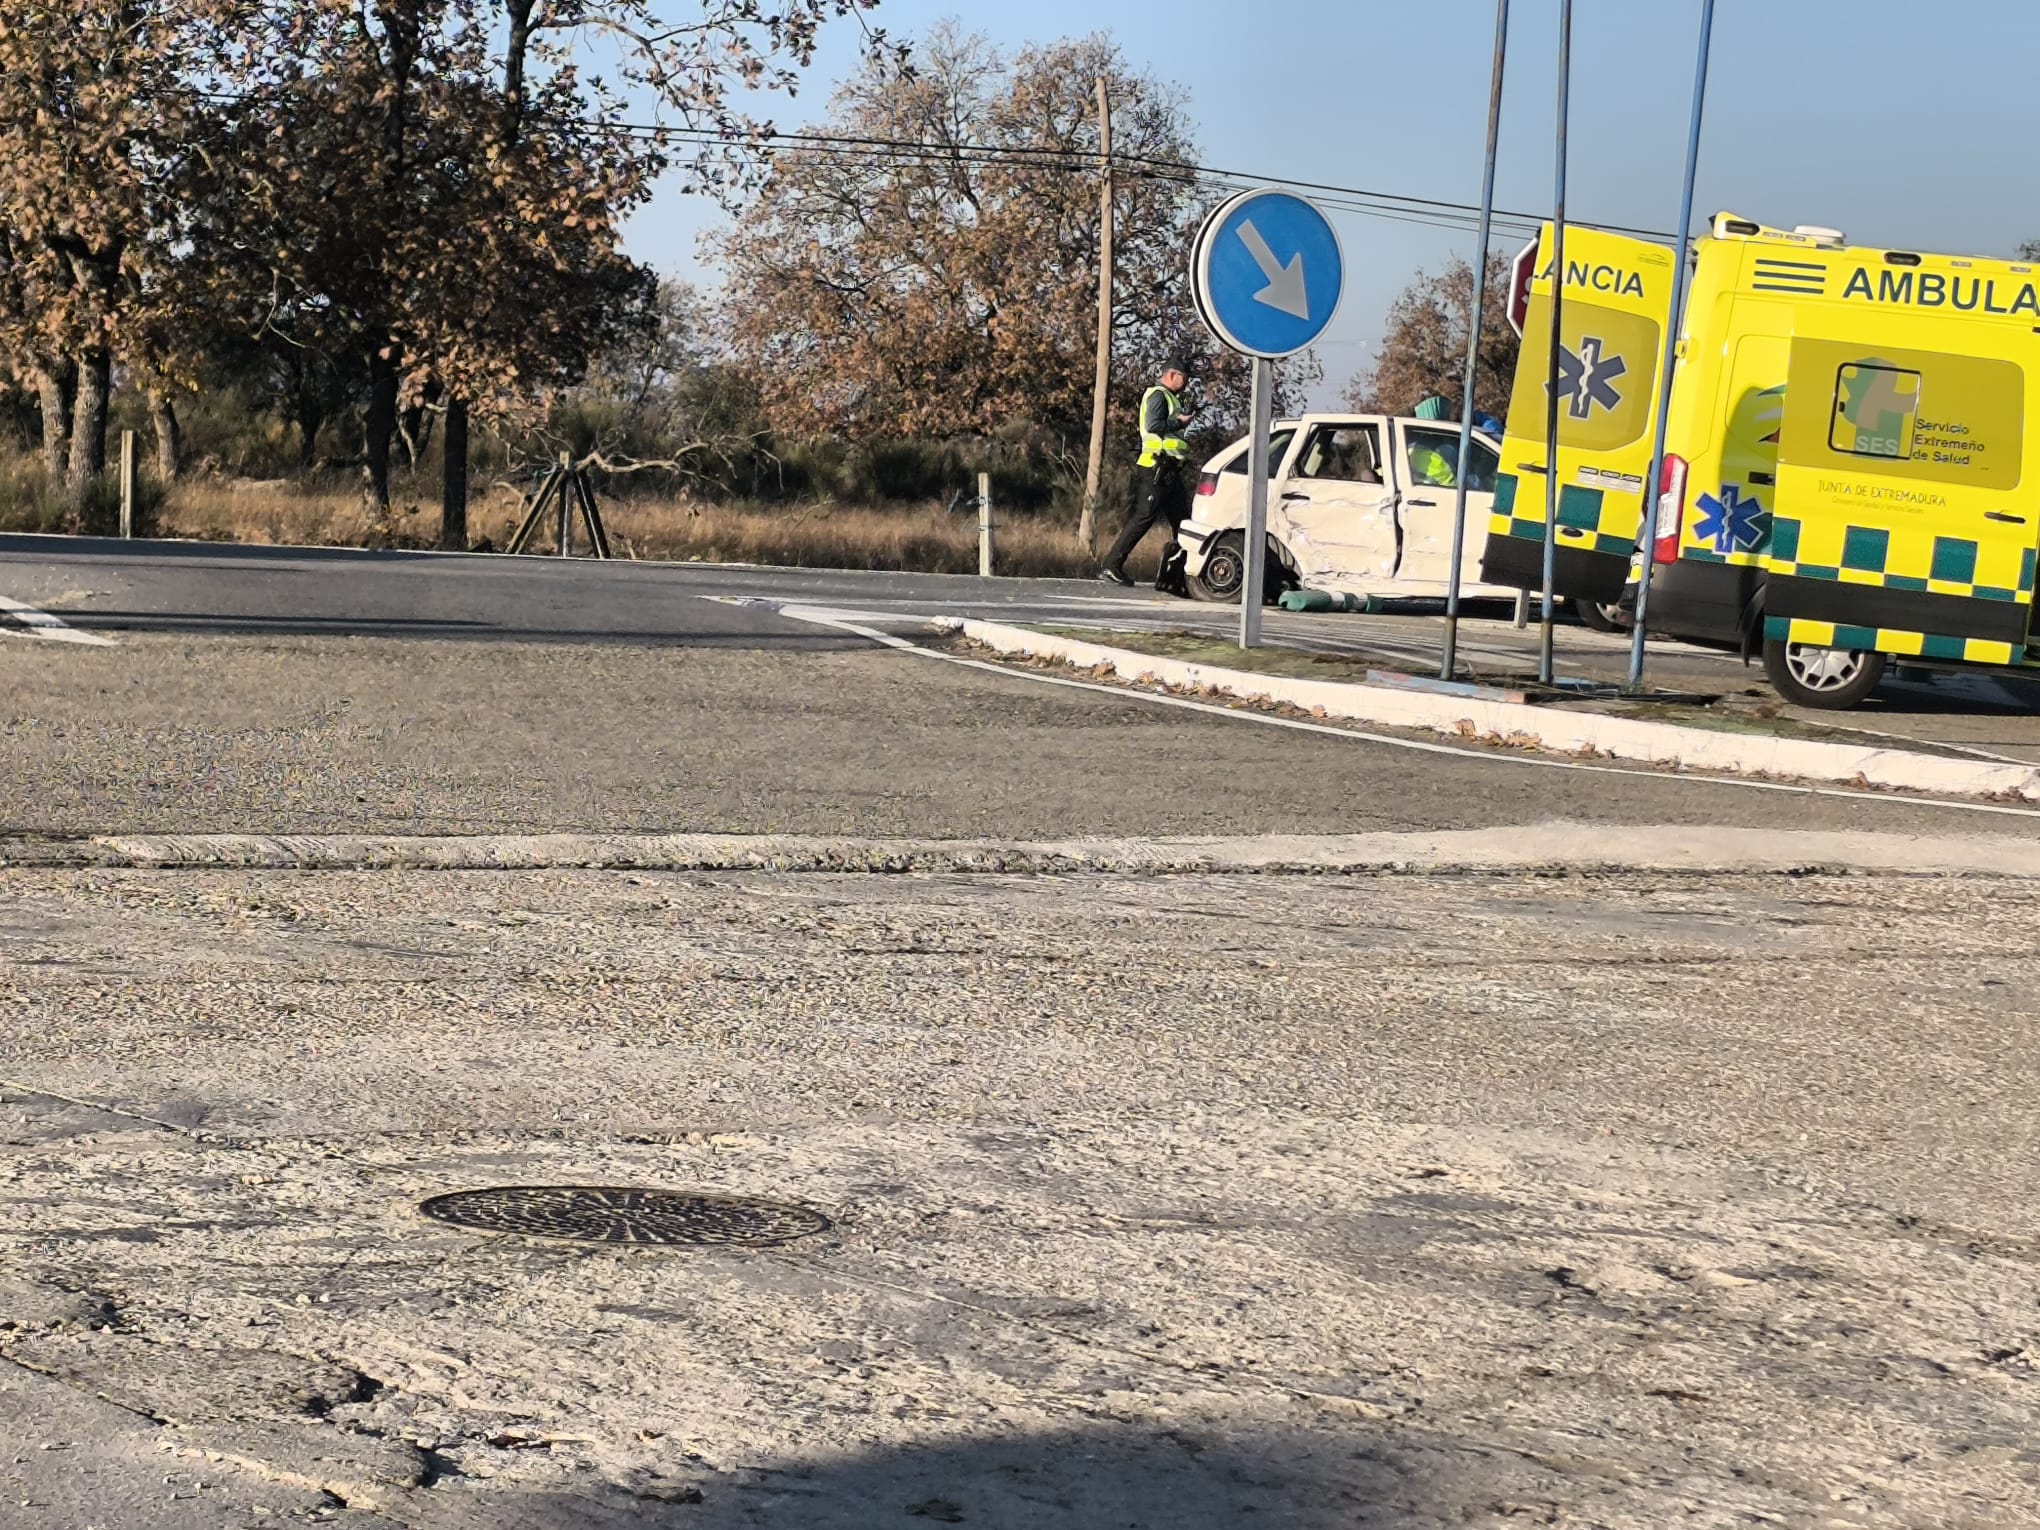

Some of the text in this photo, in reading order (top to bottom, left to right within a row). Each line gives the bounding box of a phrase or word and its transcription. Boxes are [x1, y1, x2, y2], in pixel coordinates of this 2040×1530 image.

[1842, 267, 2040, 317] AMBULA
[1915, 418, 1970, 435] Servicio
[1856, 435, 1898, 454] SES
[1914, 434, 1985, 452] Extremeño
[1912, 450, 1970, 465] de Salud
[1818, 480, 1852, 495] JUNTA
[1855, 484, 1867, 497] DE
[1871, 487, 1946, 507] EXTREMADURA
